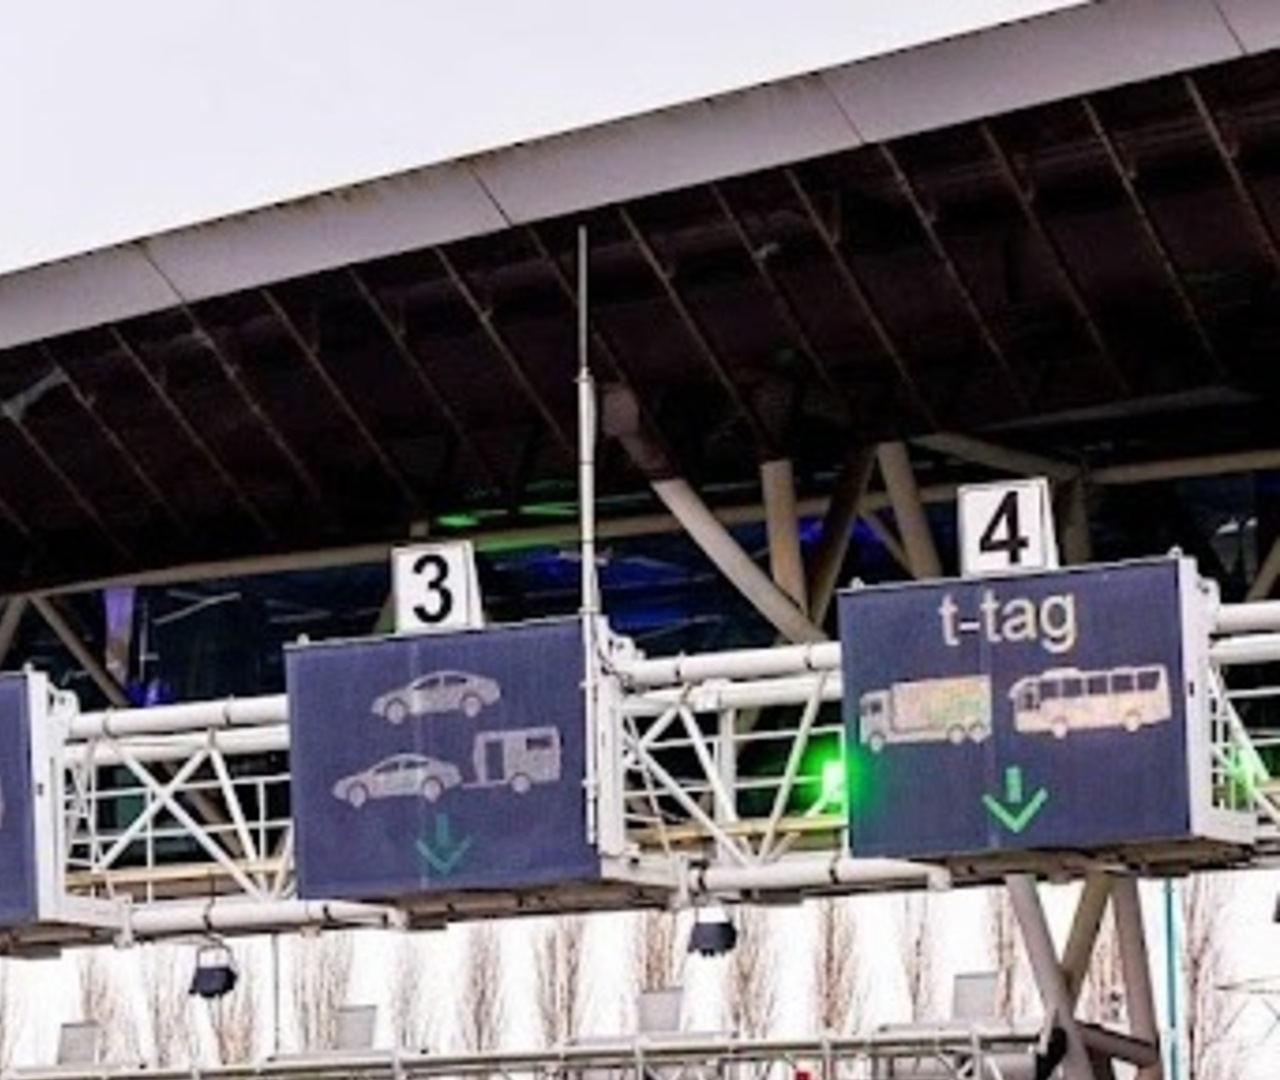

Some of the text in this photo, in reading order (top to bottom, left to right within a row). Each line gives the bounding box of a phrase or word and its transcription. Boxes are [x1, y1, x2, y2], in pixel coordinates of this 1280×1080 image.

[979, 491, 1029, 564] 4
[413, 554, 453, 623] 3
[939, 590, 1077, 653] t-tag
